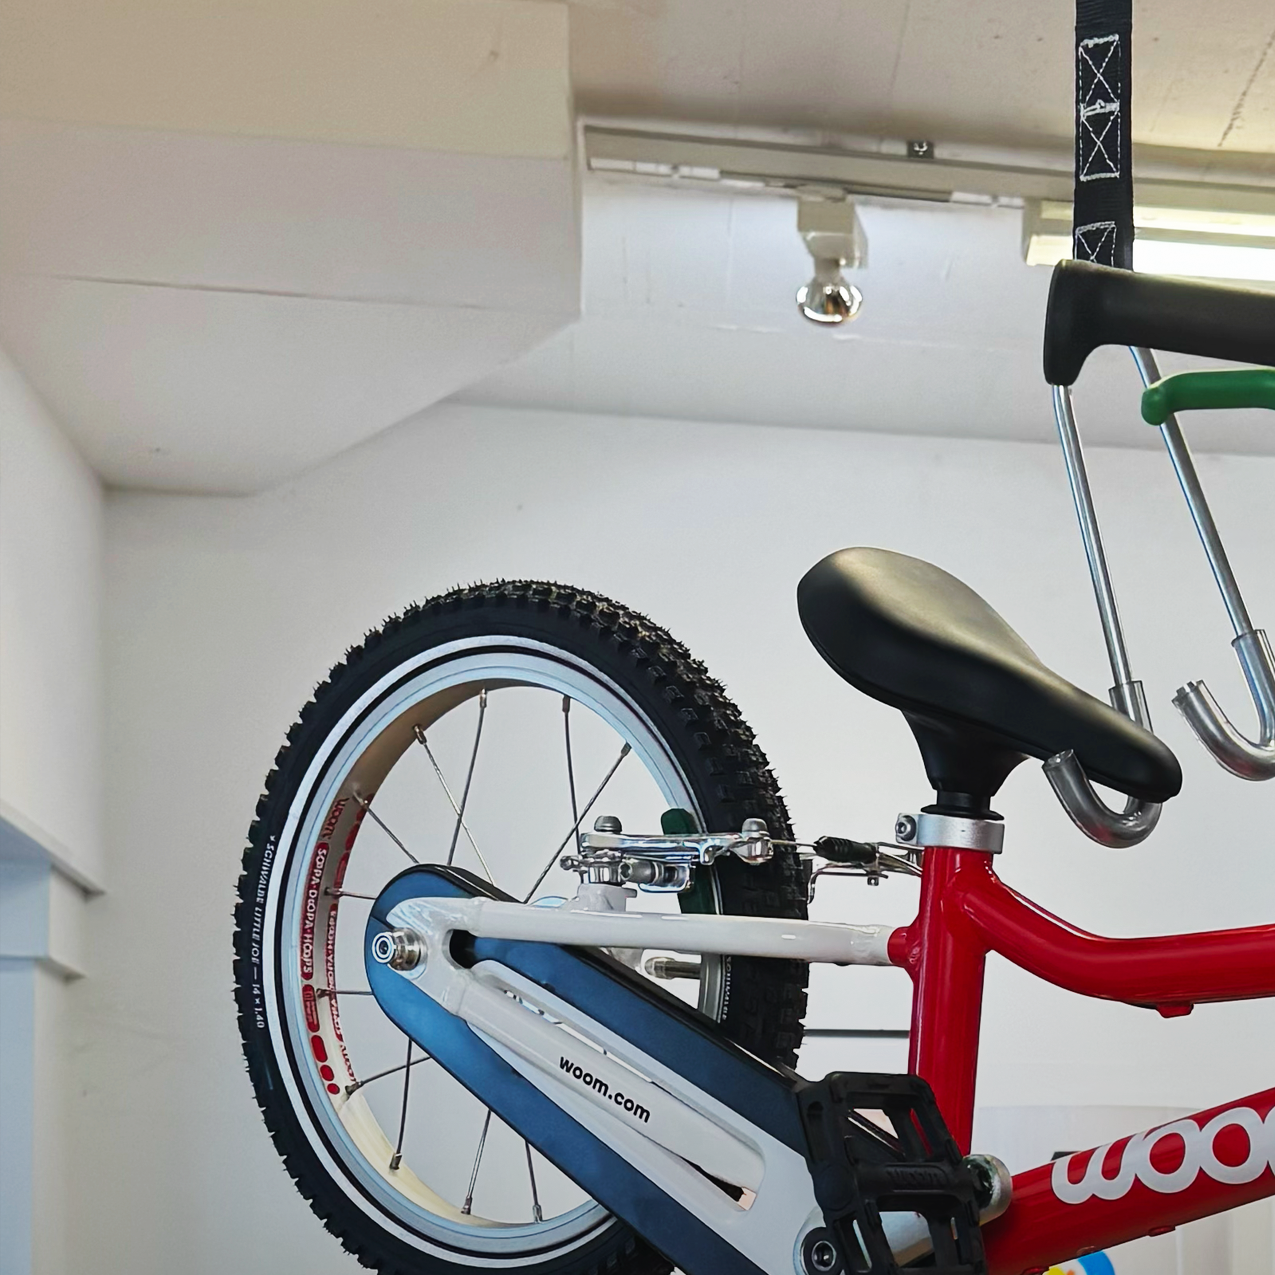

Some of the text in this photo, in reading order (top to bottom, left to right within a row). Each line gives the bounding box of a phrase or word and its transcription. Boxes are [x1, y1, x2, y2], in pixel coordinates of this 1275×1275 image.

[321, 798, 350, 840] woom
[256, 843, 276, 904] SCHWALBE
[252, 906, 264, 941] LITTLE
[251, 942, 261, 964] JOE
[559, 1056, 651, 1123] woom.com
